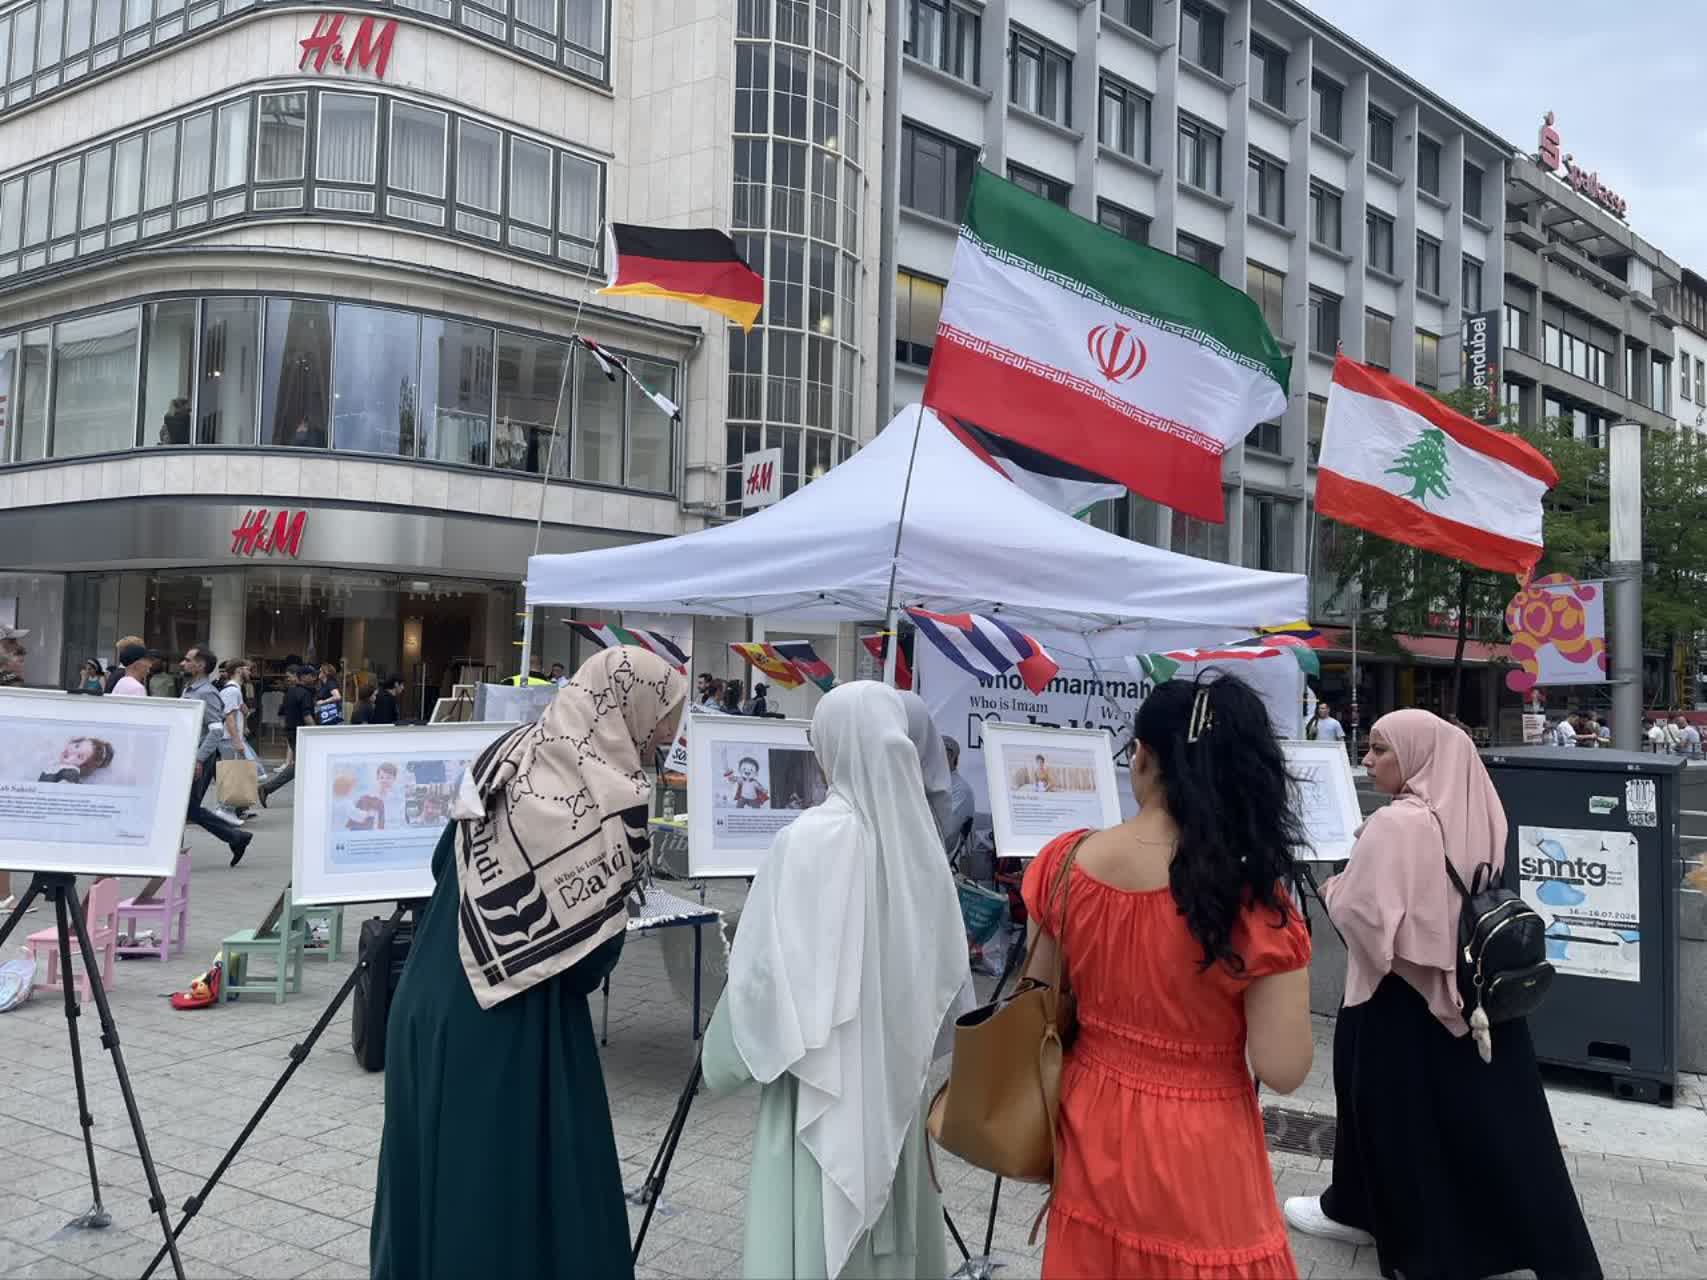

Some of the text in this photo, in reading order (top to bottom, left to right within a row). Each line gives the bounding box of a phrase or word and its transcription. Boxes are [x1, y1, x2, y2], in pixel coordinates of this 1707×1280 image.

[299, 12, 398, 78] H&M
[746, 461, 773, 495] H&M
[231, 508, 307, 557] H&M
[970, 696, 1048, 714] Who is Imam
[554, 871, 576, 885] Who
[1521, 857, 1607, 887] snntg
